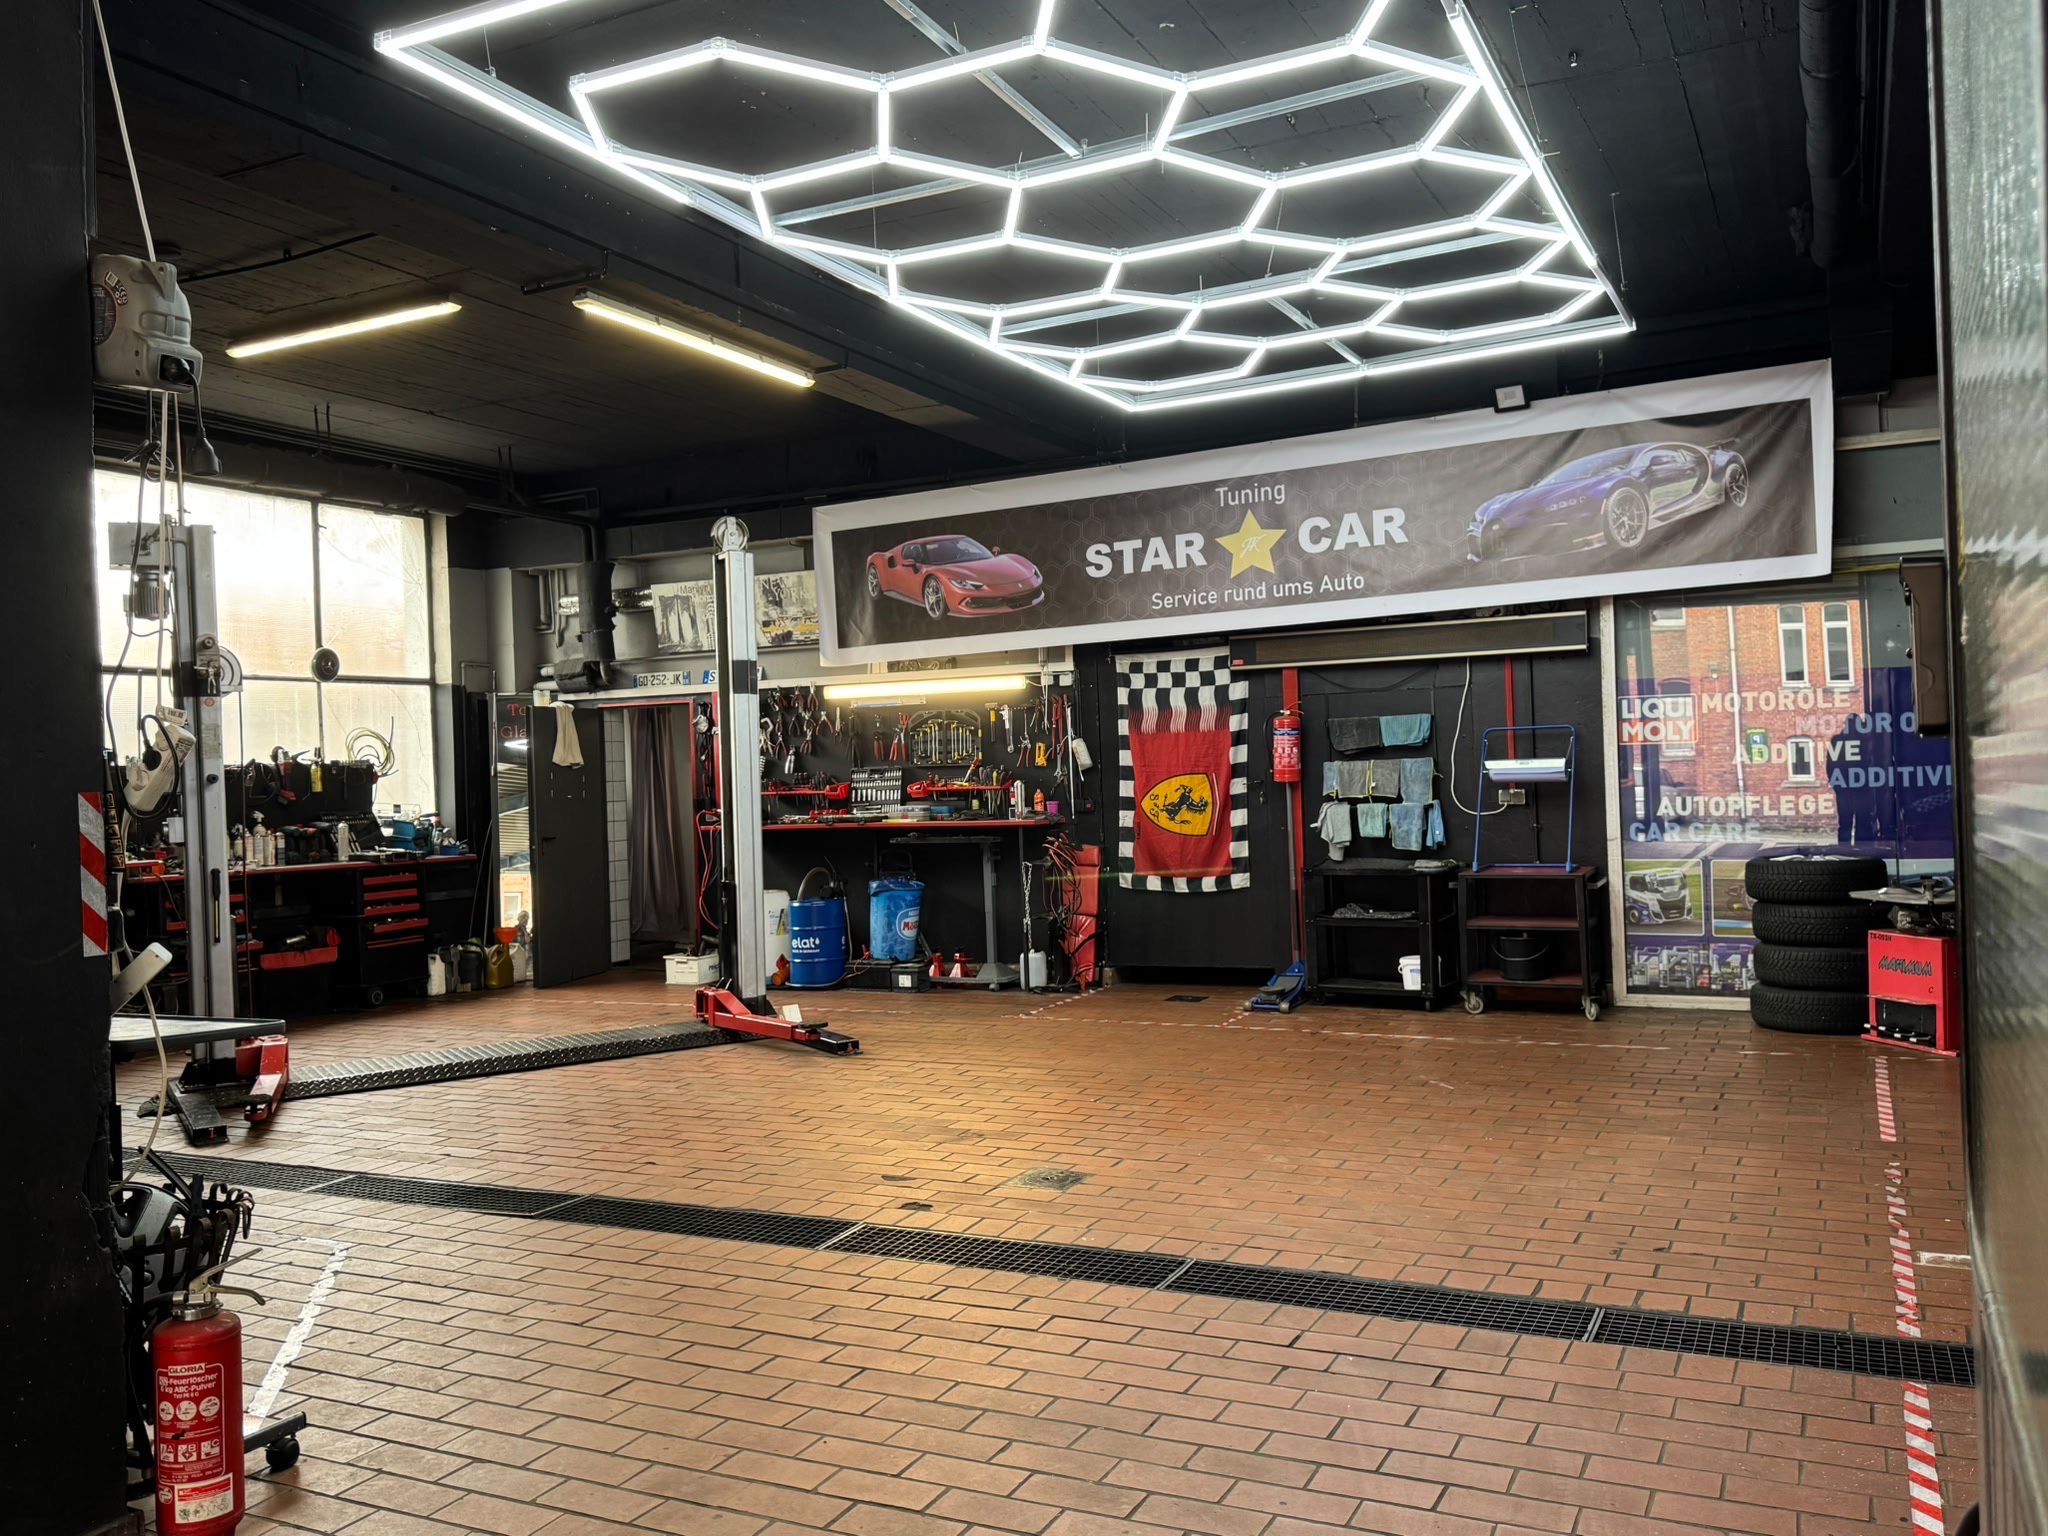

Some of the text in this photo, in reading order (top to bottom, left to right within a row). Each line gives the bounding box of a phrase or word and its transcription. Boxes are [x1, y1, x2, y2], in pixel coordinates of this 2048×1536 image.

[1215, 483, 1286, 507] Tuning
[1085, 507, 1409, 578] STAR CAR
[1151, 574, 1365, 610] Service rund ums Auto
[1621, 697, 1694, 719] LIQUI
[1622, 720, 1694, 742] MOLY
[1795, 712, 1893, 735] MOTOR
[1732, 740, 1862, 764] ADDITIVE
[1656, 793, 1835, 816] AUTOPFLEGE
[1629, 822, 1761, 842] CAR CARE
[791, 936, 816, 949] elat
[168, 1365, 205, 1374] GLORIA
[173, 1381, 216, 1393] ABC-Pulver
[188, 1443, 197, 1452] B
[211, 1438, 220, 1447] C
